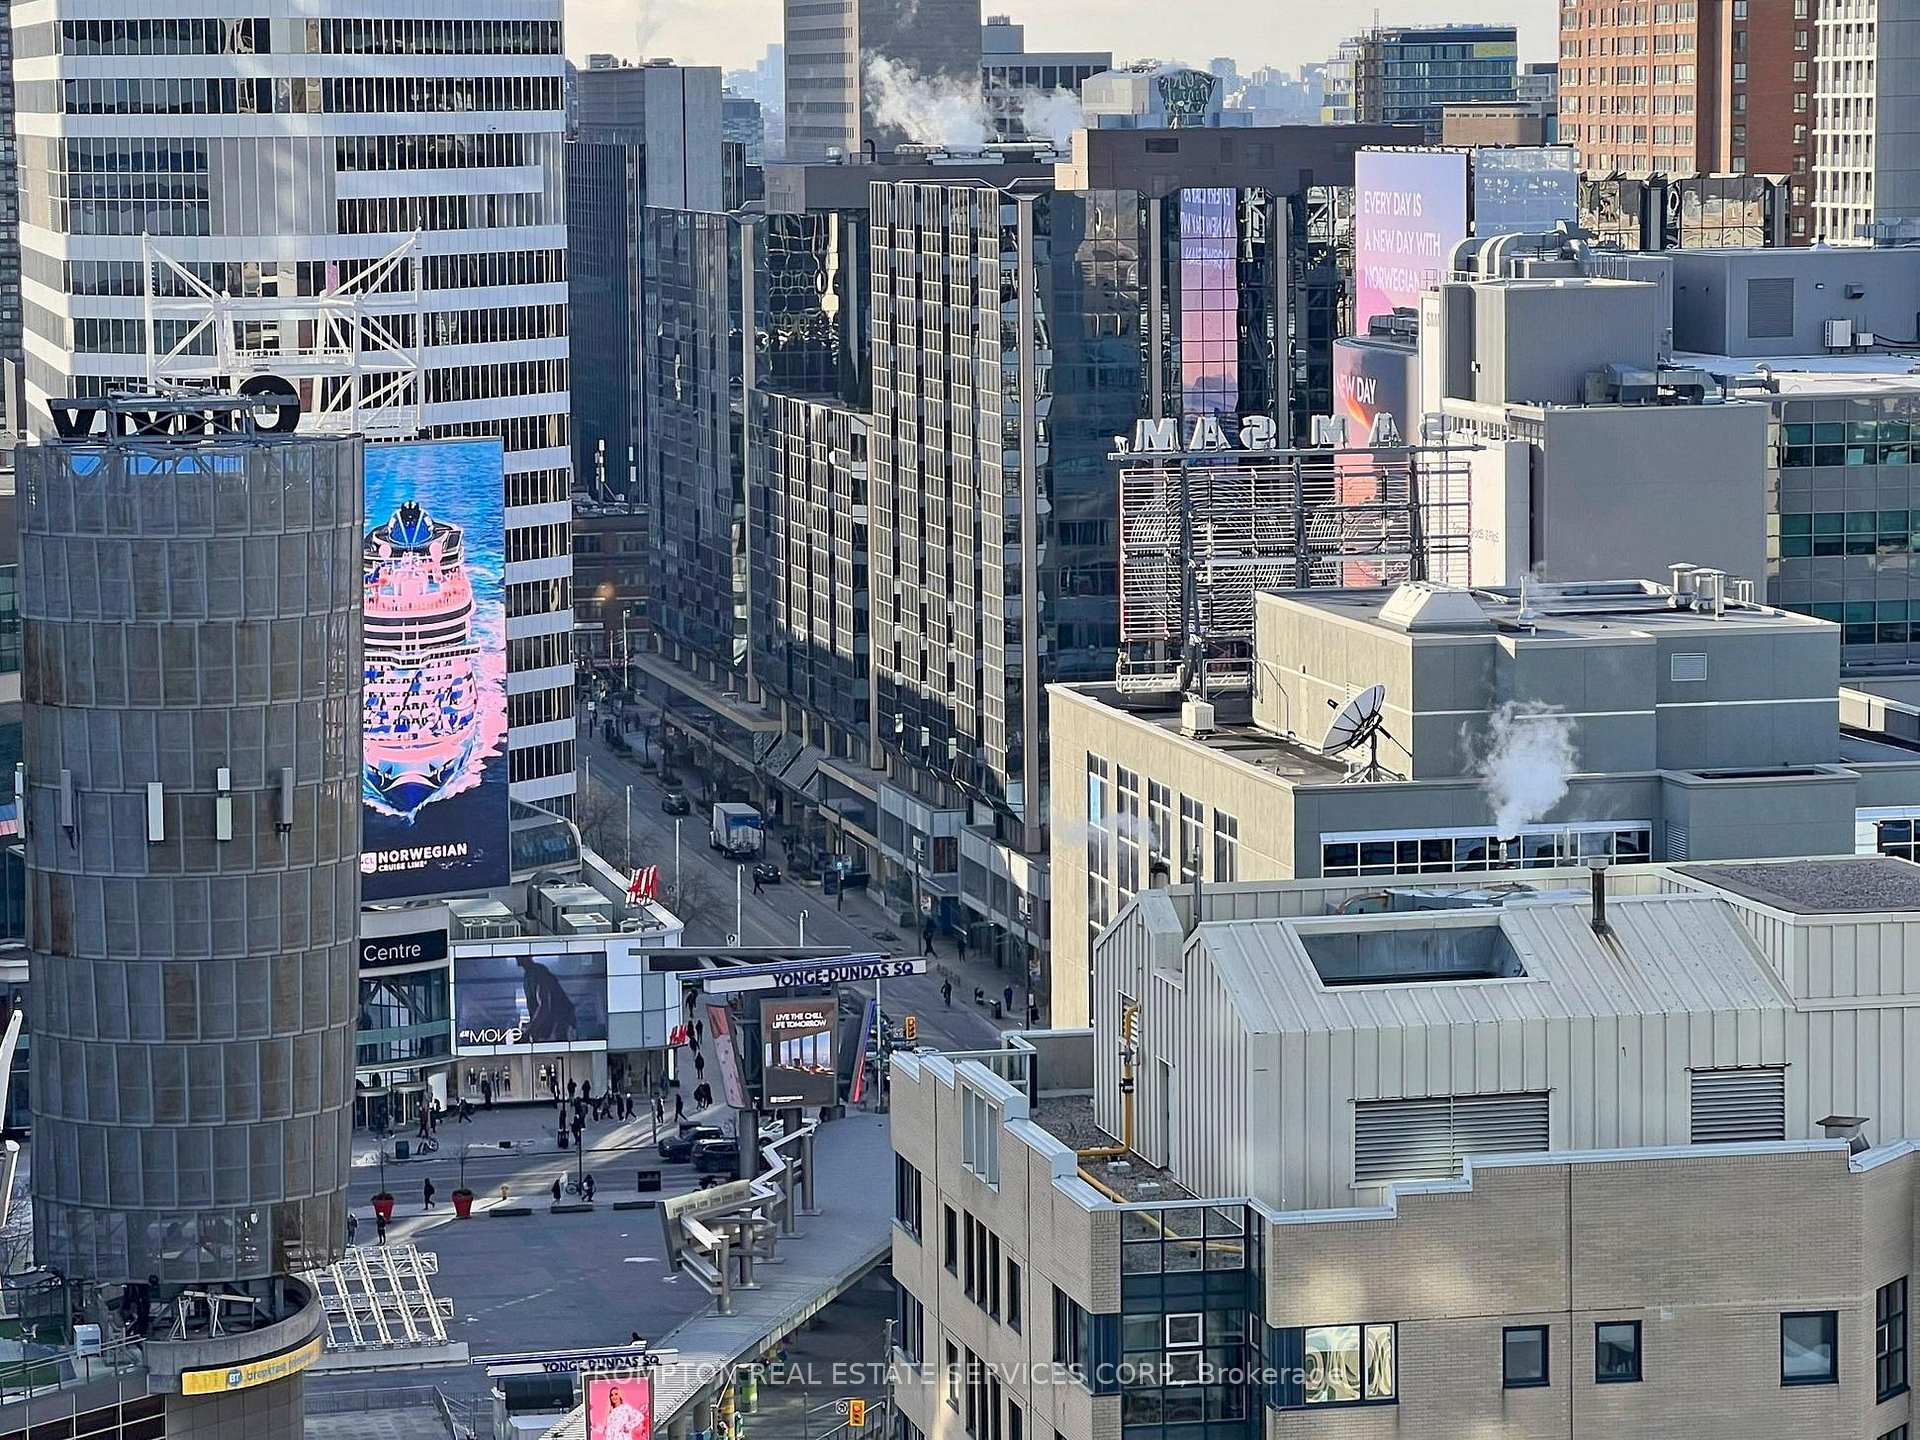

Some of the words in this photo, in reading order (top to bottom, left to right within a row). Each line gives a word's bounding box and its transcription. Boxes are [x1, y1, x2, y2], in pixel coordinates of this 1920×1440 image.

[1364, 191, 1393, 215] EVERY
[1393, 192, 1411, 216] DAY
[1413, 193, 1422, 217] IS
[1364, 228, 1371, 251] A
[1373, 229, 1395, 253] NEW
[1399, 231, 1414, 255] DAY
[1416, 231, 1441, 257] WITH
[1364, 264, 1420, 293] NORWEGIAN
[1357, 377, 1377, 405] DAY
[378, 843, 468, 864] NORWEGIAN
[378, 860, 406, 872] CRUISE
[363, 943, 421, 962] Centre
[773, 965, 890, 987] YONGE-DUNDAS
[893, 961, 914, 976] SQ
[772, 1021, 785, 1029] LIFE
[786, 1019, 827, 1028] TOMORROW
[775, 1013, 790, 1021] LIVE
[790, 1012, 804, 1020] THE
[804, 1012, 823, 1020] CHILL
[643, 1355, 660, 1366] SQ
[229, 1373, 241, 1383] BT
